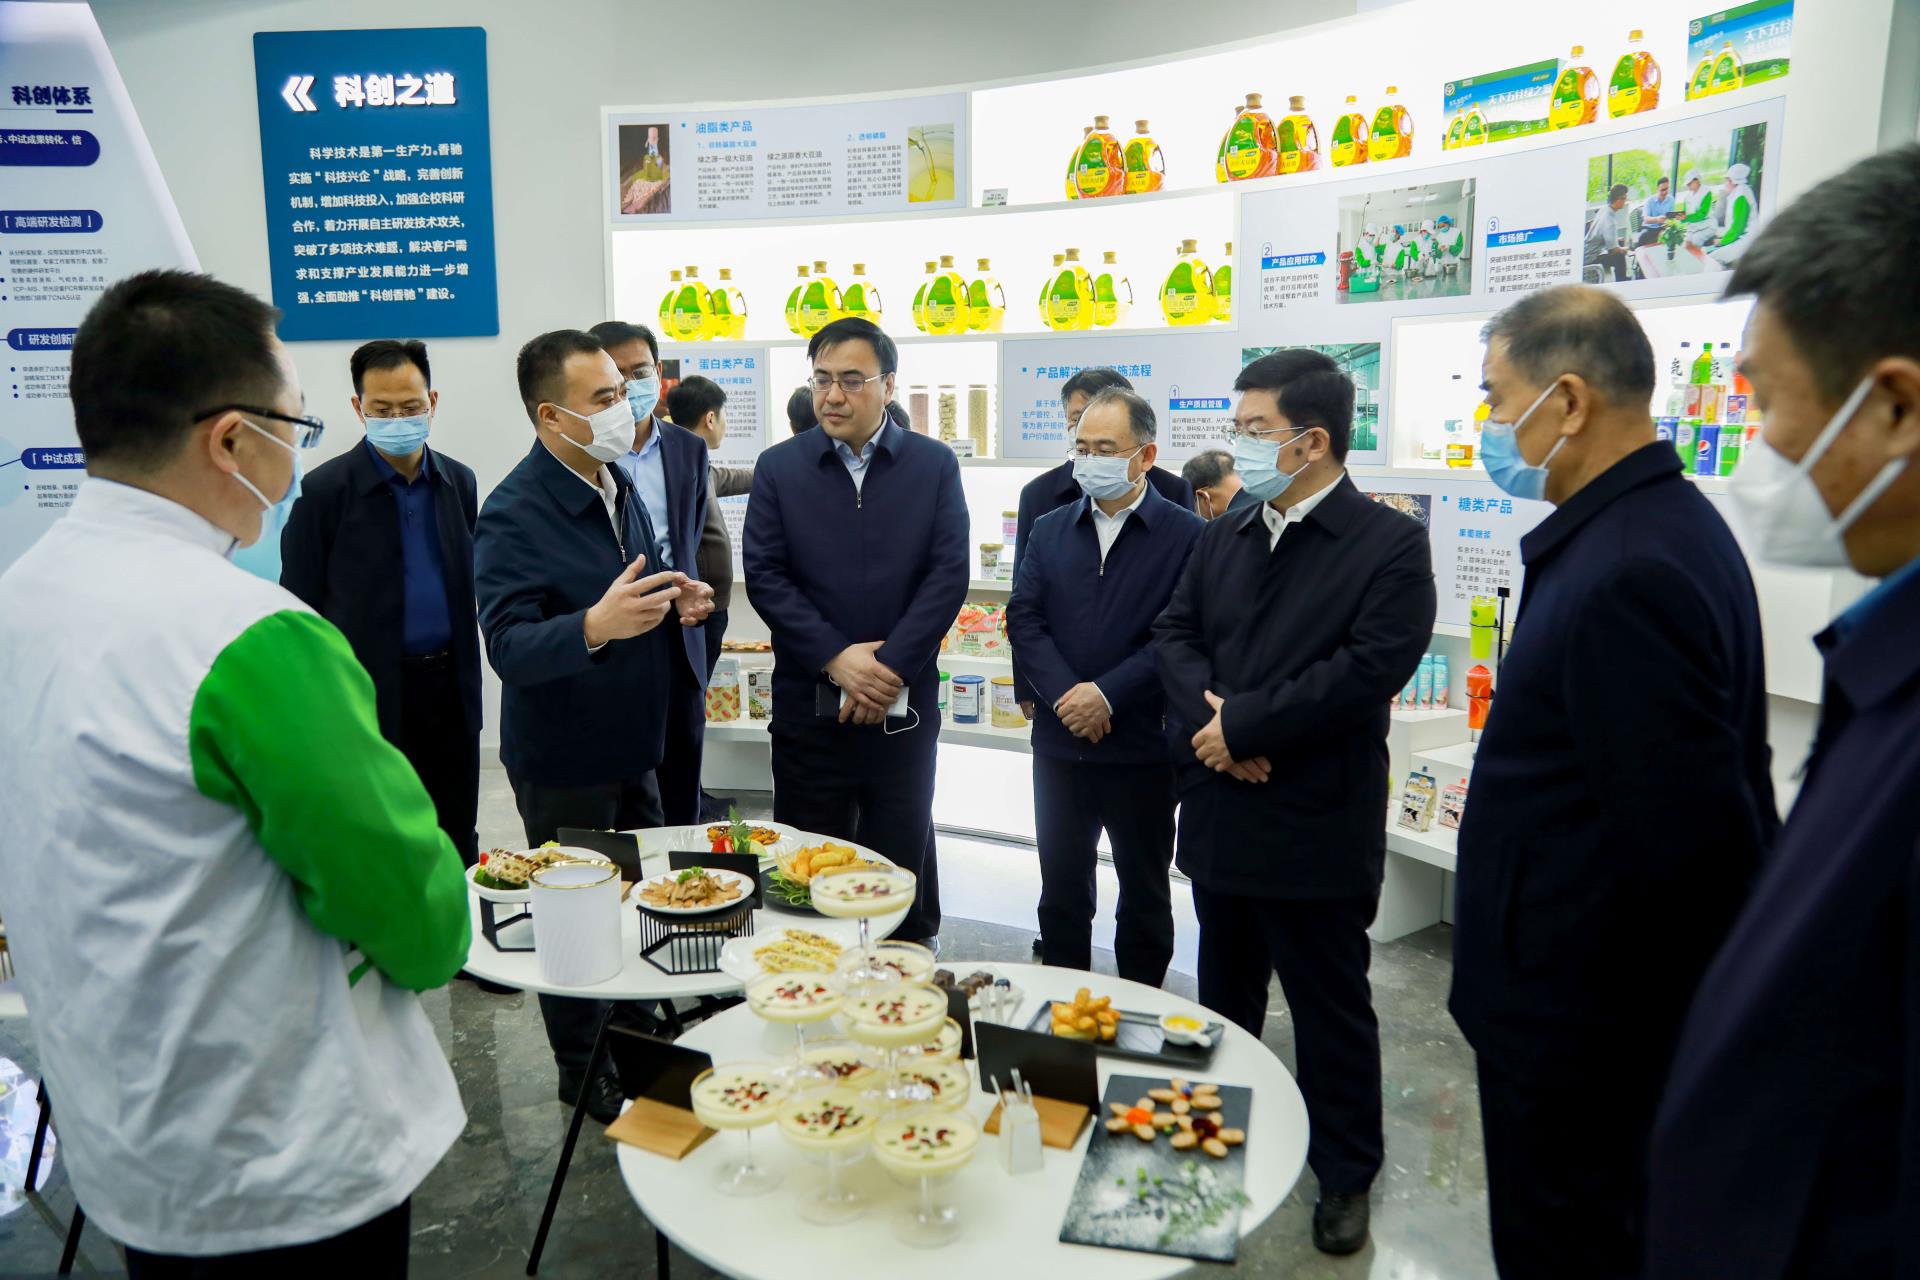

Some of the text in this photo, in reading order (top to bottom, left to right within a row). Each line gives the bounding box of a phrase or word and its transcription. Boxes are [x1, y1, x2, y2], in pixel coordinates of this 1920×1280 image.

[11, 86, 92, 106] 科创体系
[333, 72, 457, 109] 科创之道
[696, 120, 753, 134] 油脂类产品
[309, 143, 464, 160] 科学技术是第一生产力。香驰
[288, 167, 464, 185] 实施“科技兴企”战略，完善创新
[290, 191, 465, 210] 机制，增加科技投入，加强企校科研
[292, 216, 466, 234] 合作，着力开展自主研发技术攻关，
[1490, 221, 1496, 232] 3
[1498, 231, 1534, 244] 市场推广
[293, 239, 468, 257] 突破了多项技术难题，解决客户需
[1264, 247, 1270, 256] 2
[1271, 255, 1317, 267] 产品应用研究
[295, 263, 469, 281] 求和支撑产业发展能力进一步增
[297, 287, 456, 305] 强，全面助推“科创香驰”建设。
[699, 357, 755, 369] 蛋白类产品
[1172, 389, 1177, 397] 1
[1179, 400, 1223, 409] 生产质量管理
[1458, 496, 1513, 514] 糖类产品
